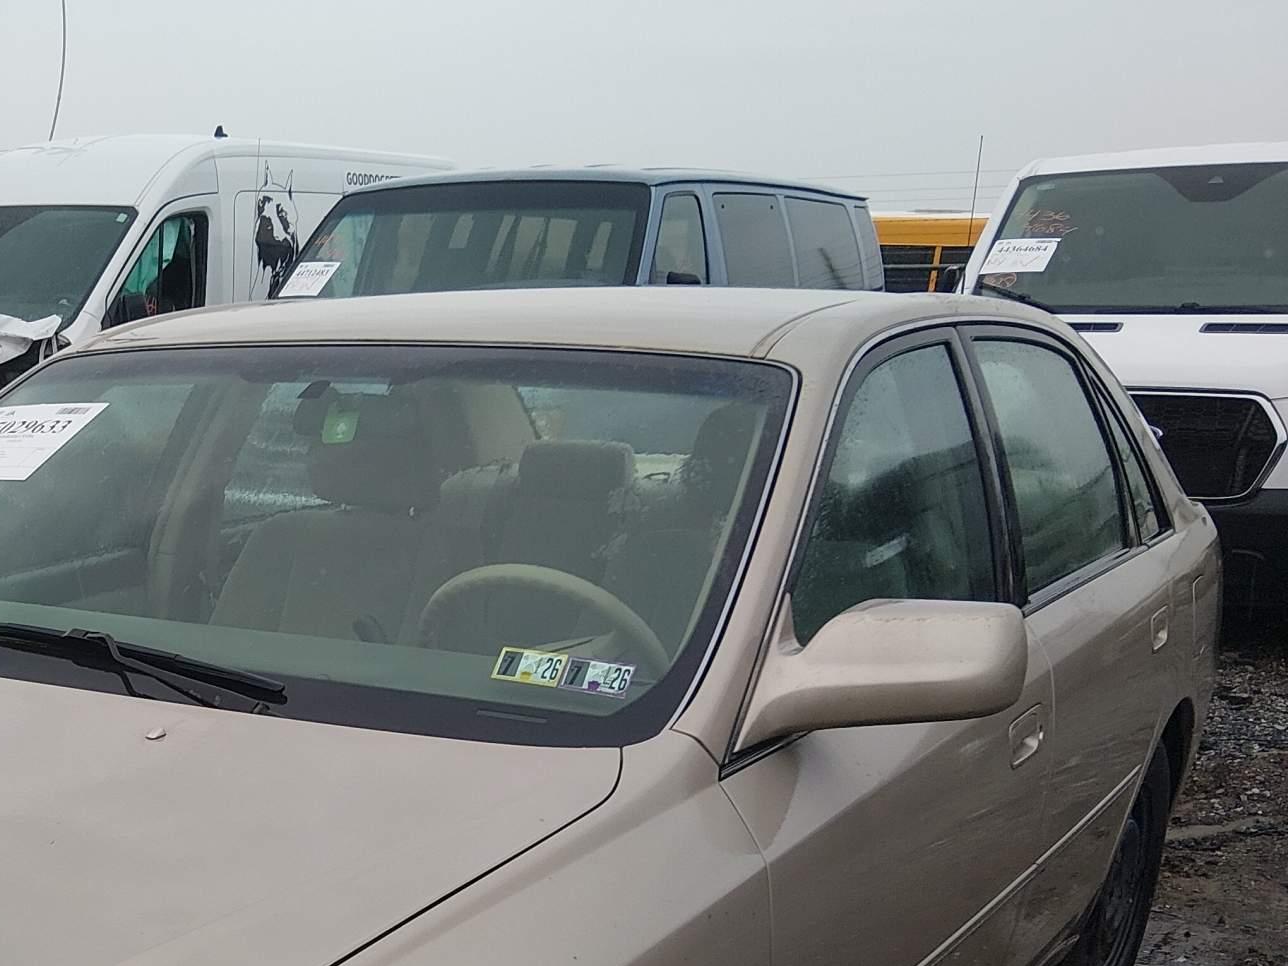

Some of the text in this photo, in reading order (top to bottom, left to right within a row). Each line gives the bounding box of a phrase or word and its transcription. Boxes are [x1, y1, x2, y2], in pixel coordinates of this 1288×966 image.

[997, 245, 1049, 254] 44364684
[540, 658, 562, 681] 26
[608, 667, 631, 692] 26
